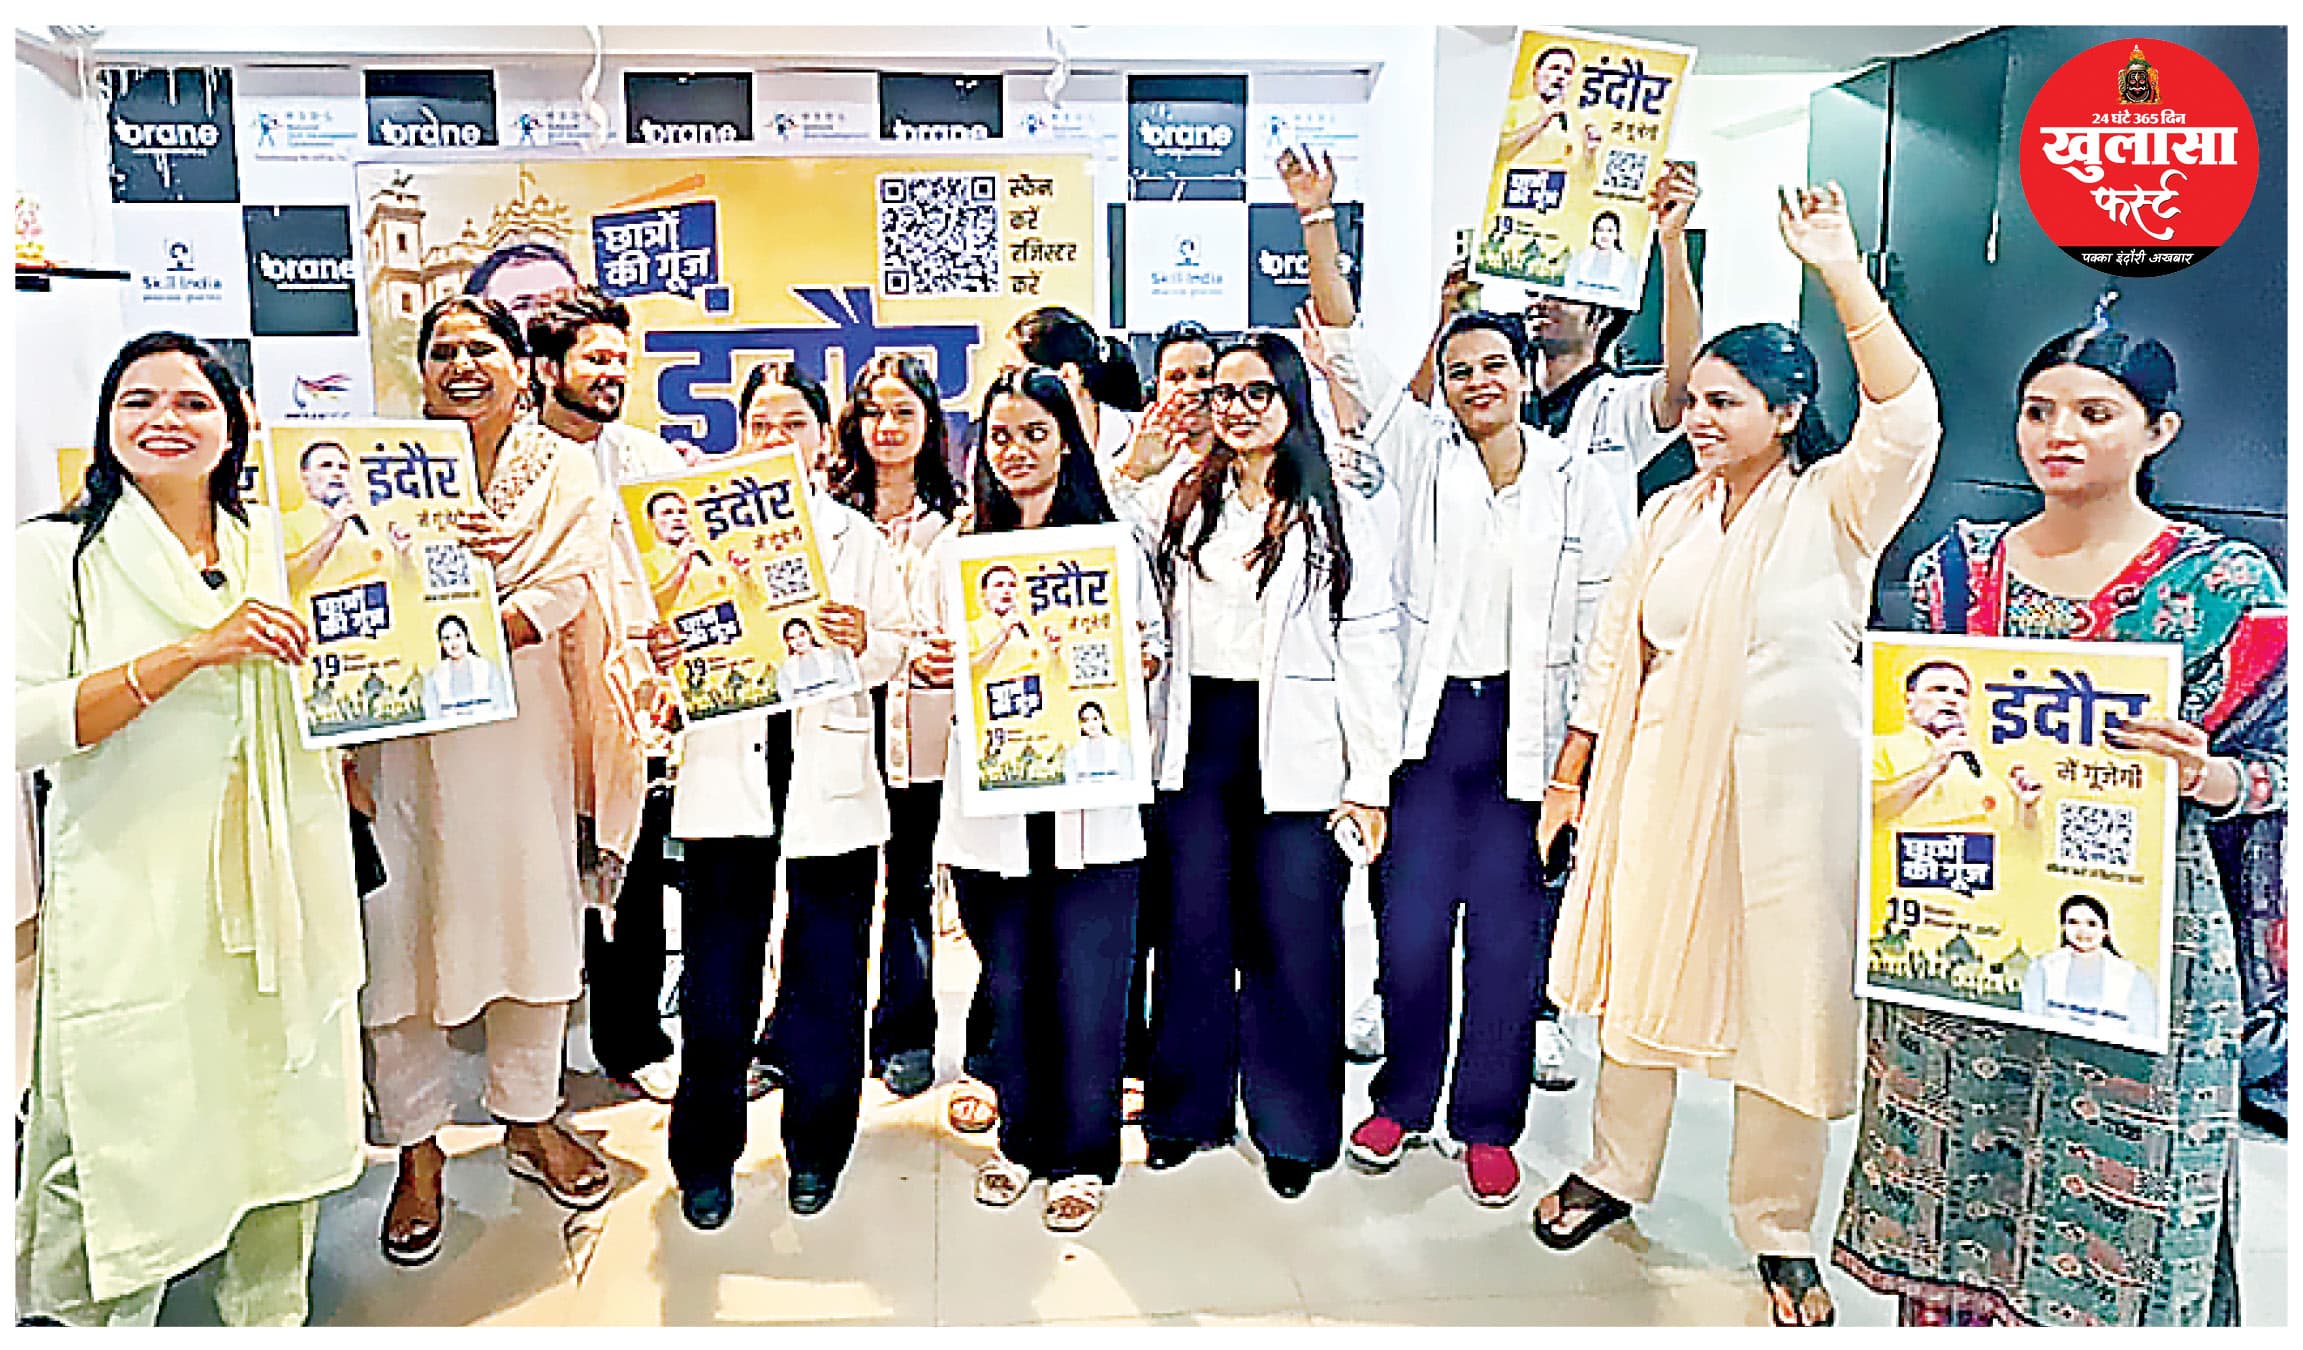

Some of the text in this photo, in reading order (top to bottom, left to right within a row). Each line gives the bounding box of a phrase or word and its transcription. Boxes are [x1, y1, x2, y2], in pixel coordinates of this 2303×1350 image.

[1577, 56, 1672, 115] इंदौर
[601, 210, 680, 253] छात्रों
[603, 250, 650, 286] की
[359, 442, 461, 506] इंदौर
[694, 475, 795, 541] इंदौर
[1025, 559, 1110, 616] इंदौर
[312, 654, 340, 678] 19
[683, 656, 706, 679] 19
[1886, 897, 1922, 927] 19
